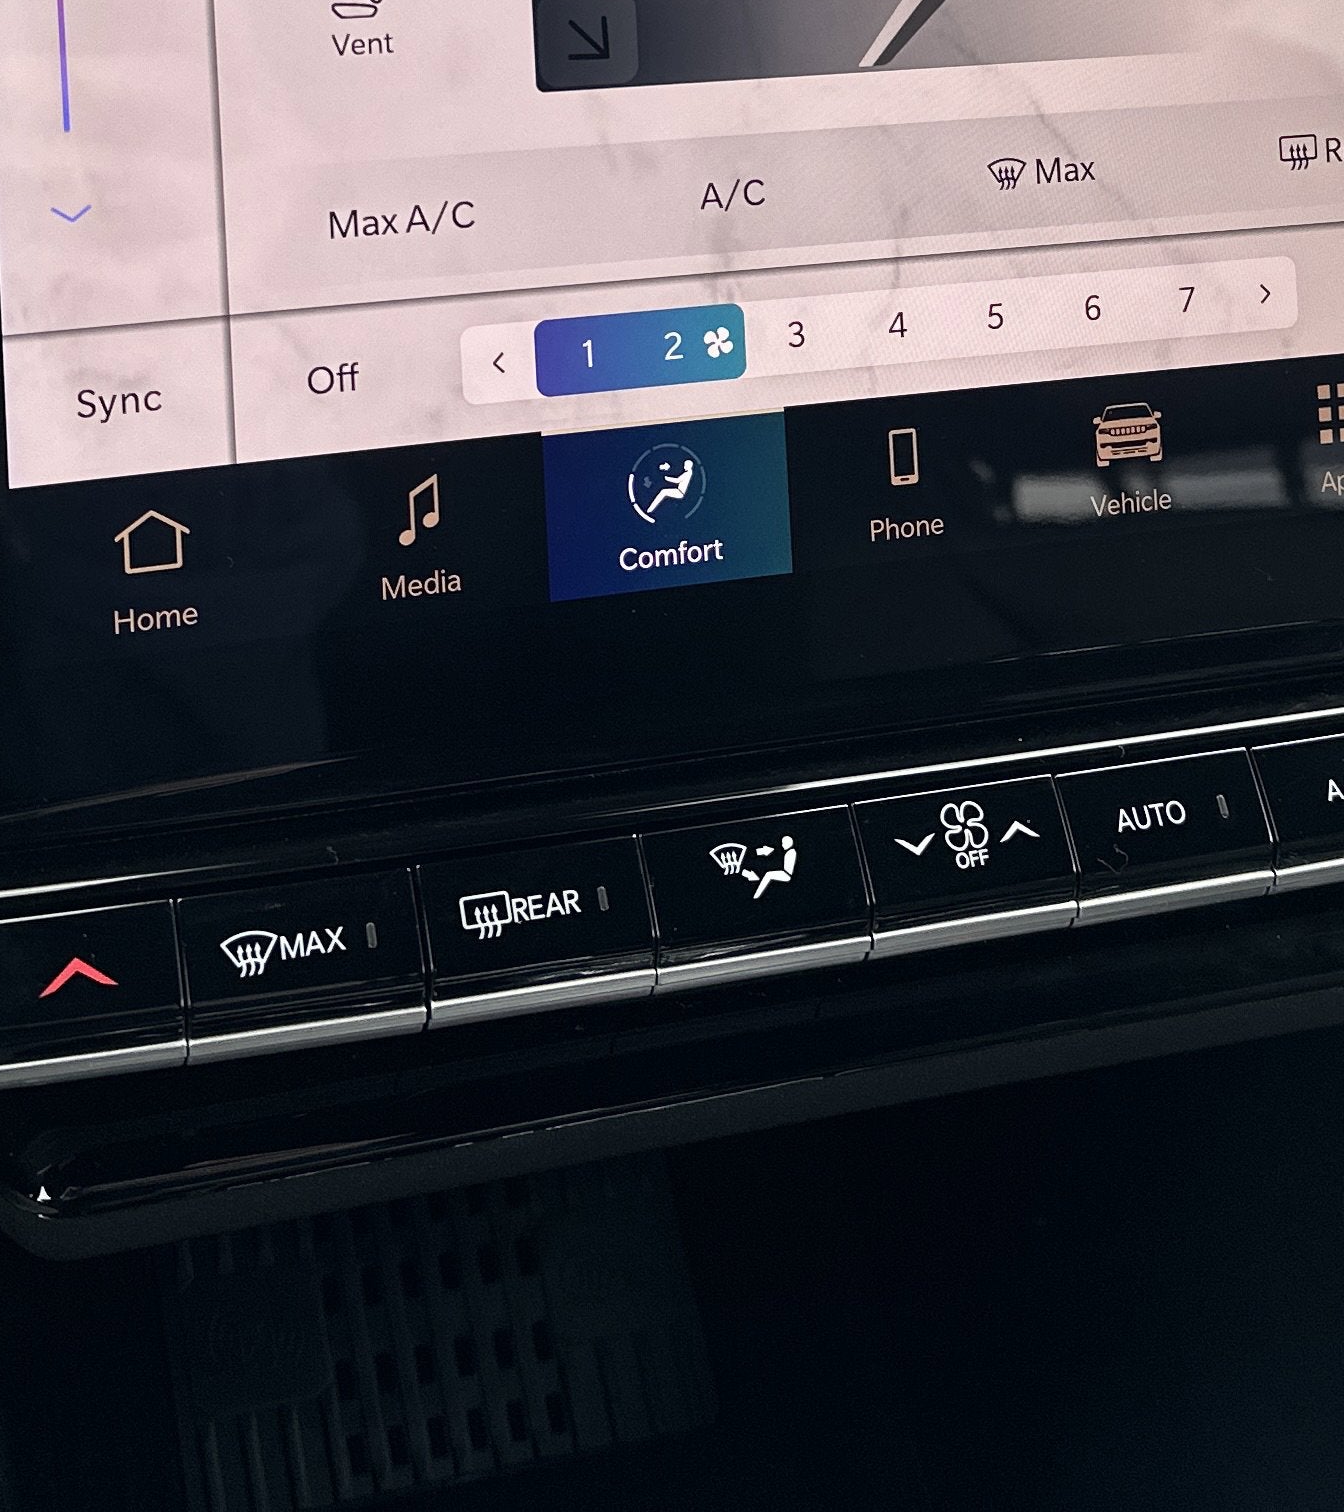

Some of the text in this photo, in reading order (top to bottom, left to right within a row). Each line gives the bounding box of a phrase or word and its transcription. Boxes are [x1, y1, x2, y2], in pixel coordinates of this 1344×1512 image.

[332, 34, 394, 56] Vent
[1036, 157, 1095, 184] Max
[701, 179, 765, 211] A/C
[330, 201, 475, 239] Max A/C
[583, 287, 1194, 367] 1 2 3 4 5 6 7
[308, 362, 359, 394] Off
[78, 390, 161, 423] Sync
[1090, 489, 1172, 517] Vehicle
[871, 518, 944, 541] Phone
[620, 540, 723, 570] Comfort
[382, 569, 461, 600] Media
[115, 608, 198, 634] Home
[1118, 801, 1185, 832] AUTO
[954, 848, 990, 870] OFF
[511, 889, 582, 923] REAR
[280, 926, 346, 960] MAX
